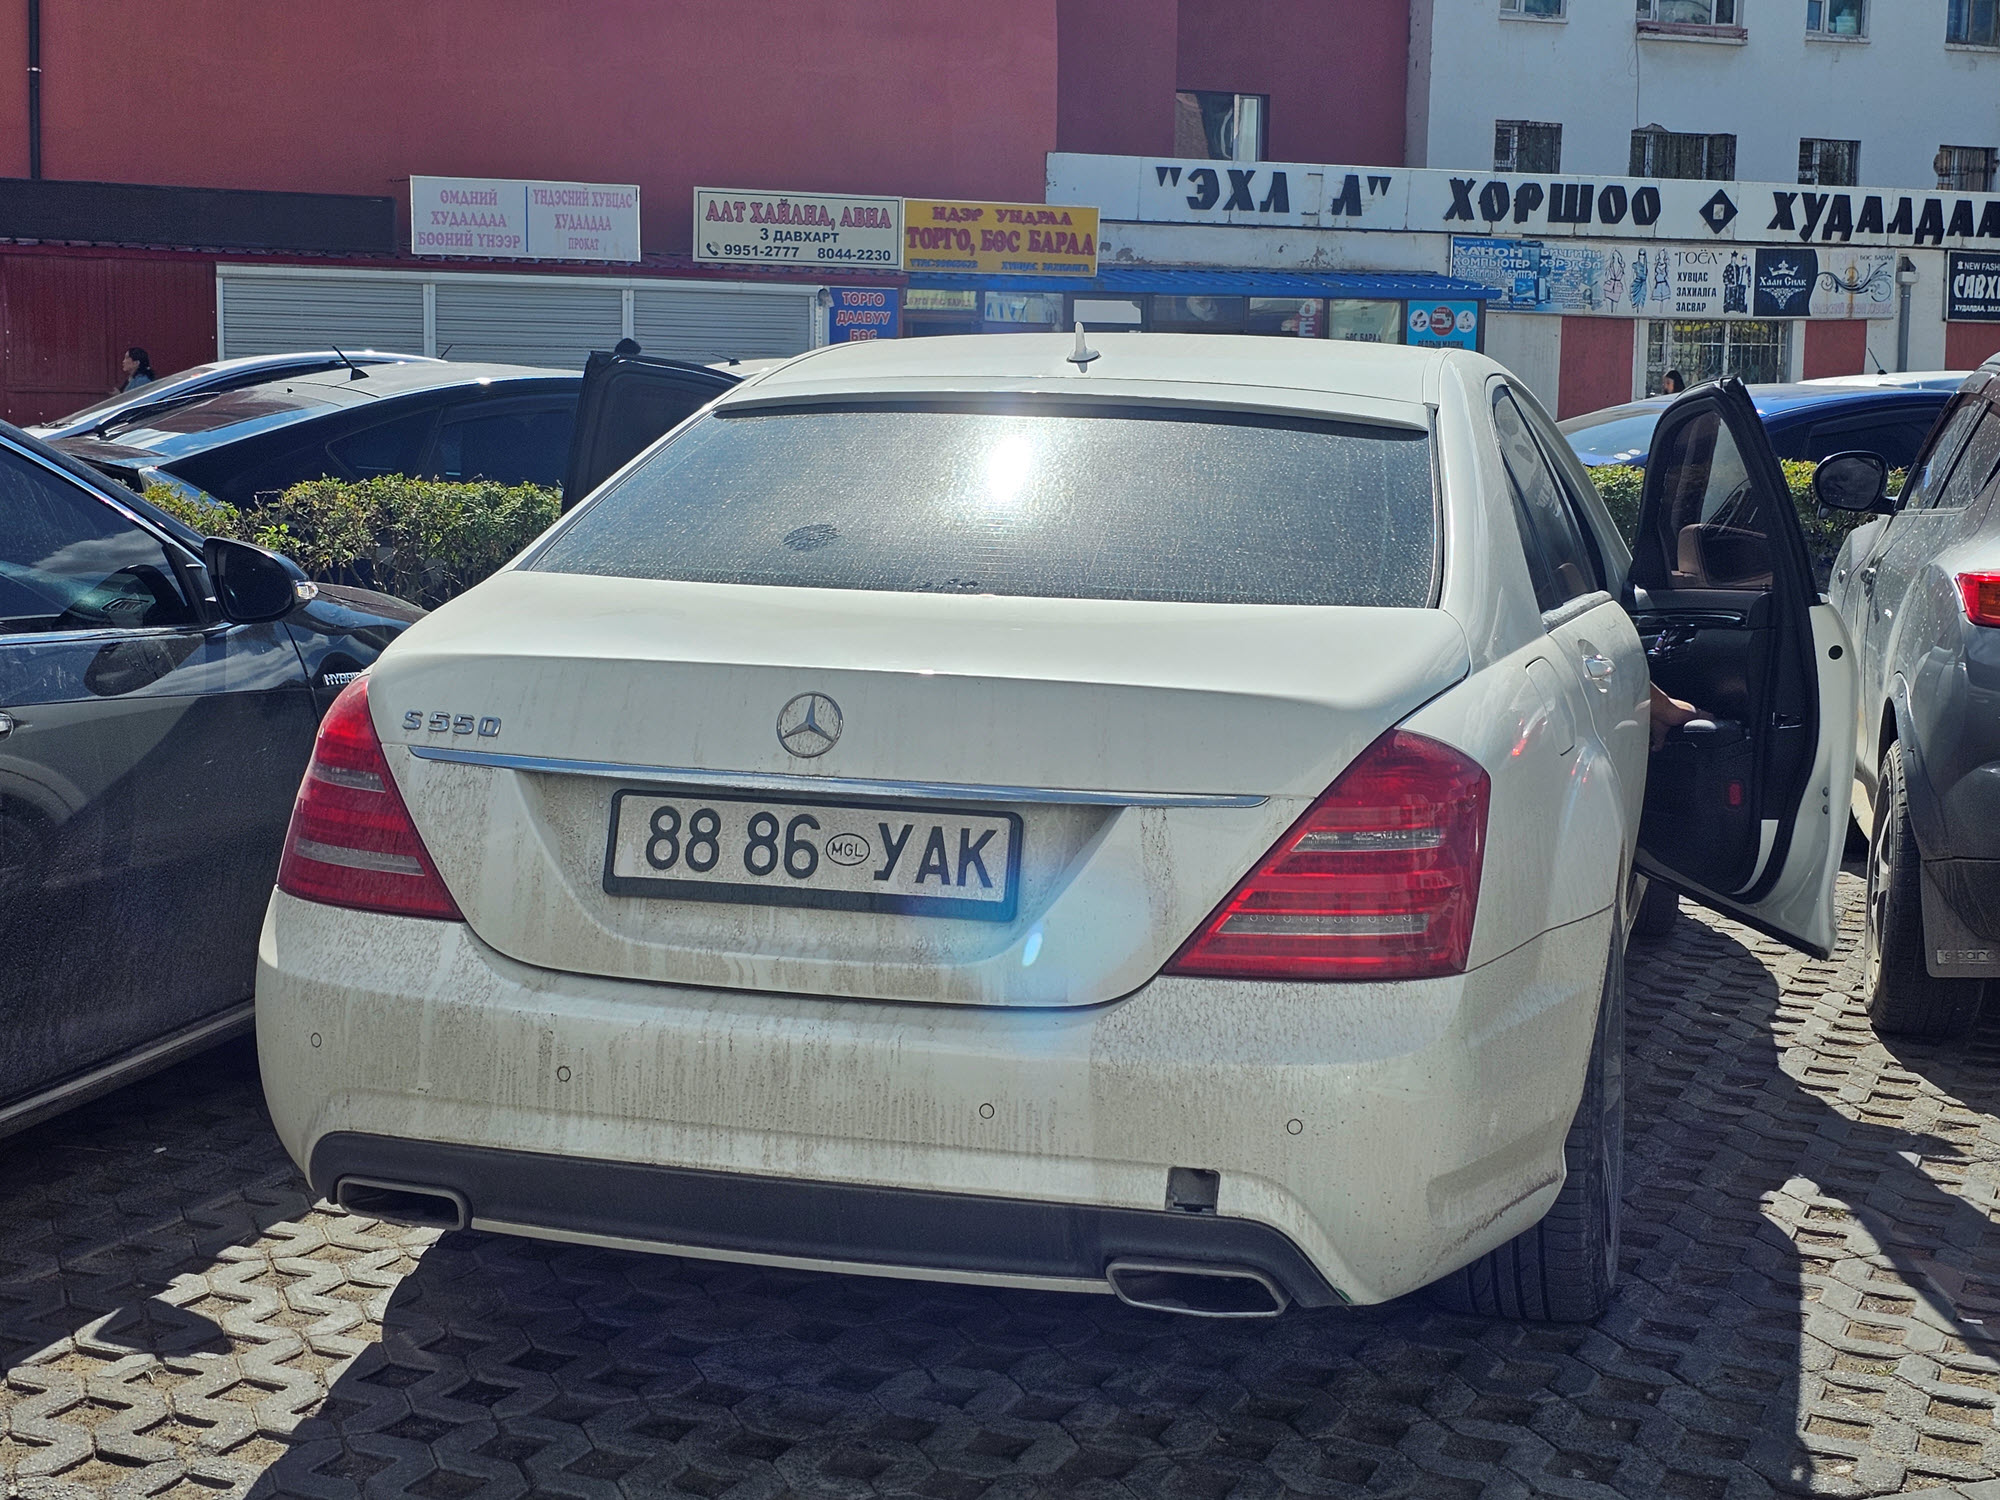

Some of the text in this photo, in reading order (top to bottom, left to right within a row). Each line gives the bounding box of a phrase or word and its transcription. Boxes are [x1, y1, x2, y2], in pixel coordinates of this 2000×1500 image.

[440, 188, 498, 206] ӨМДНИЙ
[533, 187, 633, 209] ҮНДЭСНИЙ ХУВЦАС
[705, 198, 892, 230] АЛТ ХАЙЛНА, АВНА
[1442, 177, 1661, 226] ХОРШОО
[1766, 191, 2000, 245] ХУДАЛДАА
[430, 210, 507, 228] ХУДАЛДАА
[554, 213, 612, 232] ХУДАЛДАА
[417, 229, 521, 248] БӨӨНИЙ ҮНЭЭР
[759, 228, 840, 243] 3 ДАВХАРТ
[907, 226, 1096, 256] ТОРГО, БӨС БАРАА
[568, 237, 600, 250] ПРОКАТ
[724, 244, 891, 261] 9951-2777 8044-2230
[1454, 245, 1523, 258] КАНОН
[1453, 257, 1531, 269] КОМПЬЮТЕР
[1540, 259, 1601, 269] ХЭРЭГСЭЛ
[1964, 262, 1981, 270] NEW
[1677, 271, 1709, 283] ХУВЦАС
[842, 292, 885, 307] ТОРГО
[1676, 287, 1717, 298] ЗАХИАЛГА
[1675, 302, 1707, 313] ЗАСВАР
[836, 310, 891, 326] ДААВУУ
[850, 329, 878, 341] БӨС
[645, 805, 998, 888] 88 86 MGL УАК
